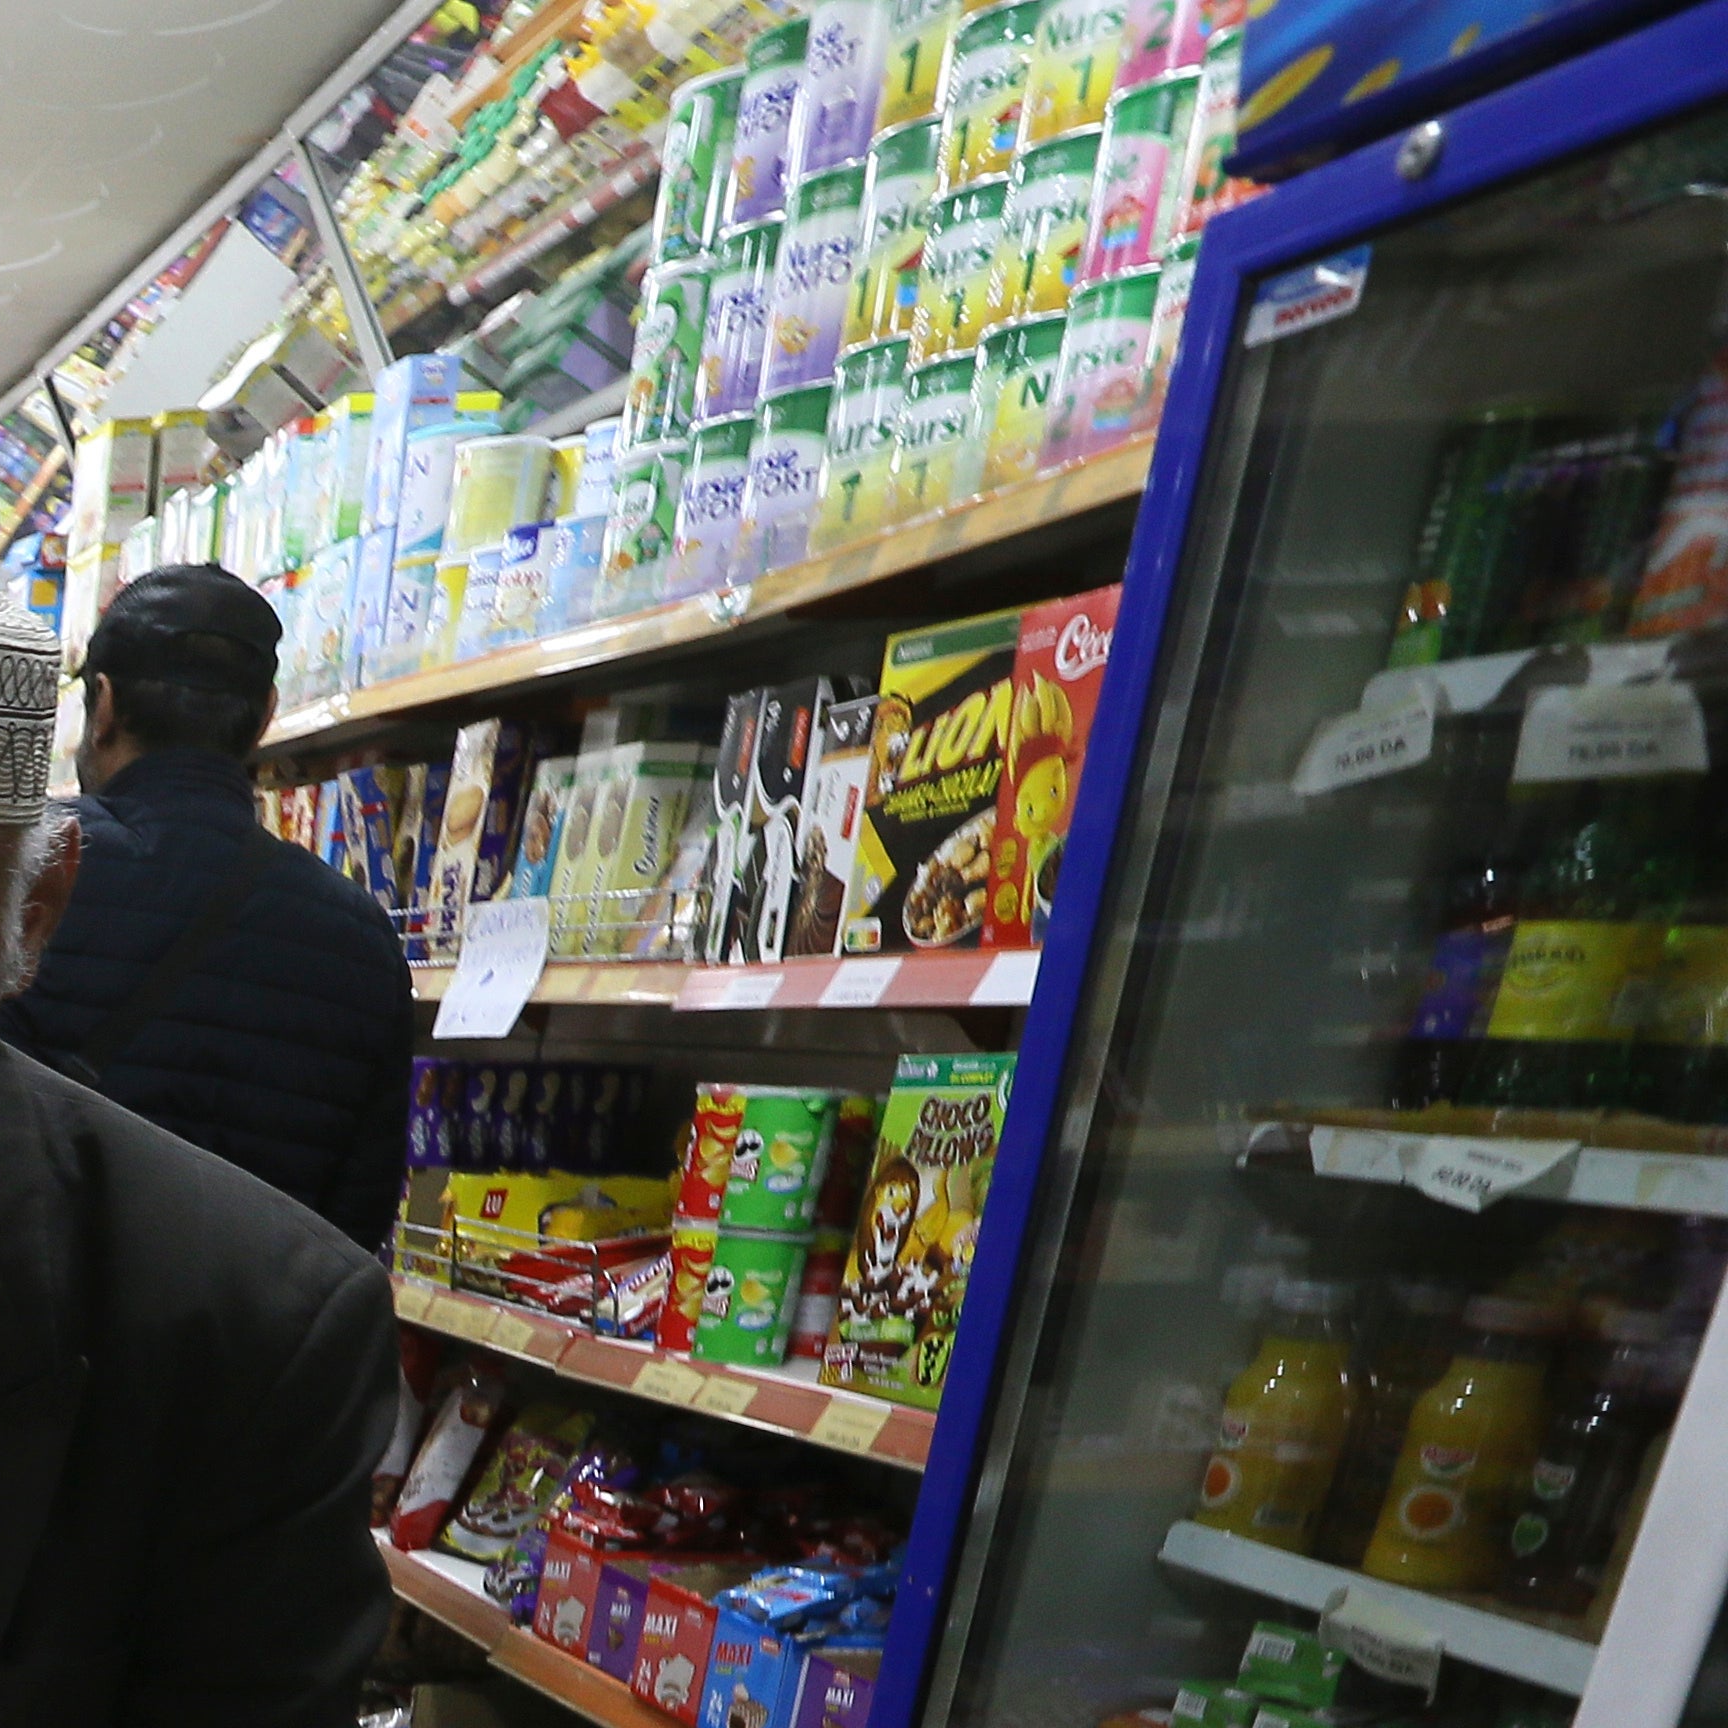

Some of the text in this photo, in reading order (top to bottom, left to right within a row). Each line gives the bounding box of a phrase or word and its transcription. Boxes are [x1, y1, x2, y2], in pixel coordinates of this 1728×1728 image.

[898, 676, 1014, 784] LION
[919, 1092, 991, 1127] CHOCO
[544, 1561, 571, 1581] MAXI
[610, 1601, 632, 1619] MAXI
[643, 1613, 678, 1639] MAXI
[715, 1643, 753, 1667] MAXI
[824, 1687, 855, 1709] MAXI
